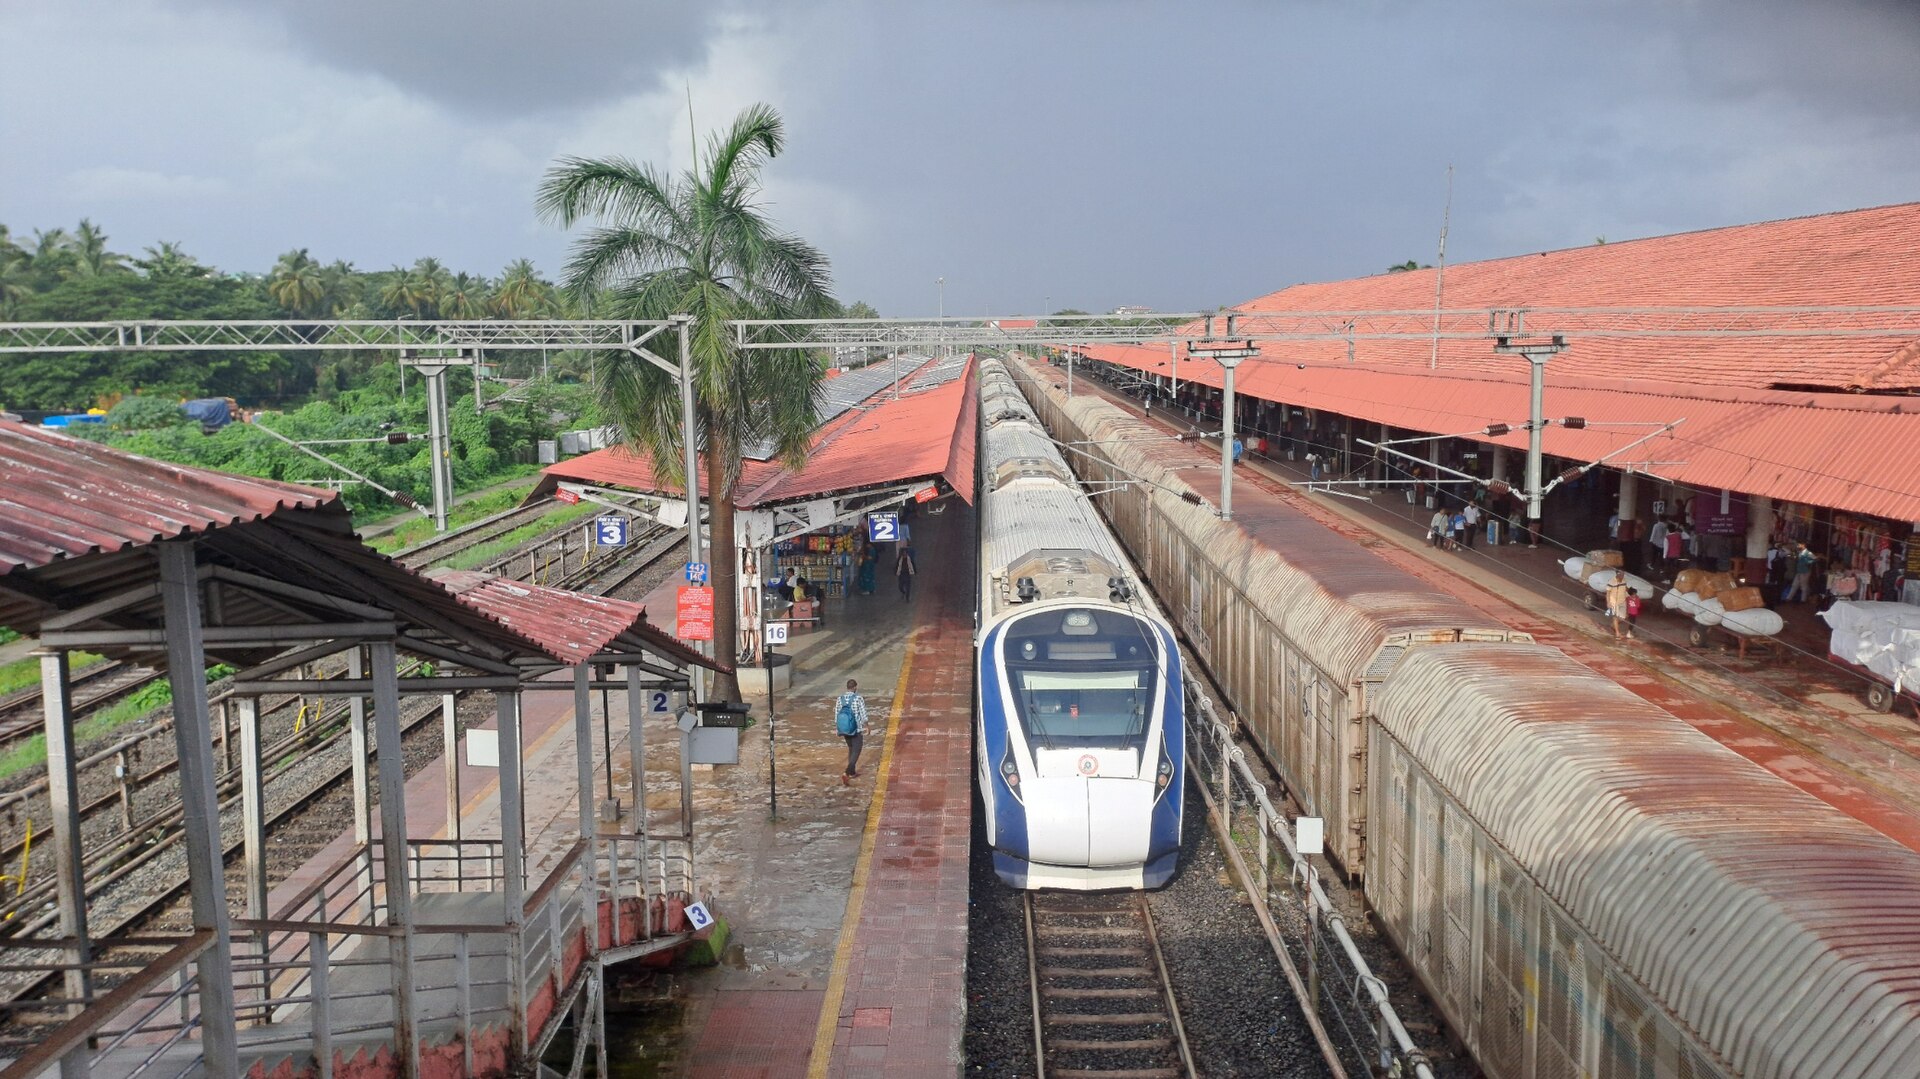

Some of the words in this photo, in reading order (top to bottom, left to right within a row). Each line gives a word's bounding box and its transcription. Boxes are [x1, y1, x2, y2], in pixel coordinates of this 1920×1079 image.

[602, 526, 621, 544] 3
[875, 522, 895, 540] 2
[768, 627, 785, 640] 16
[653, 692, 667, 711] 2
[691, 906, 707, 924] 3
